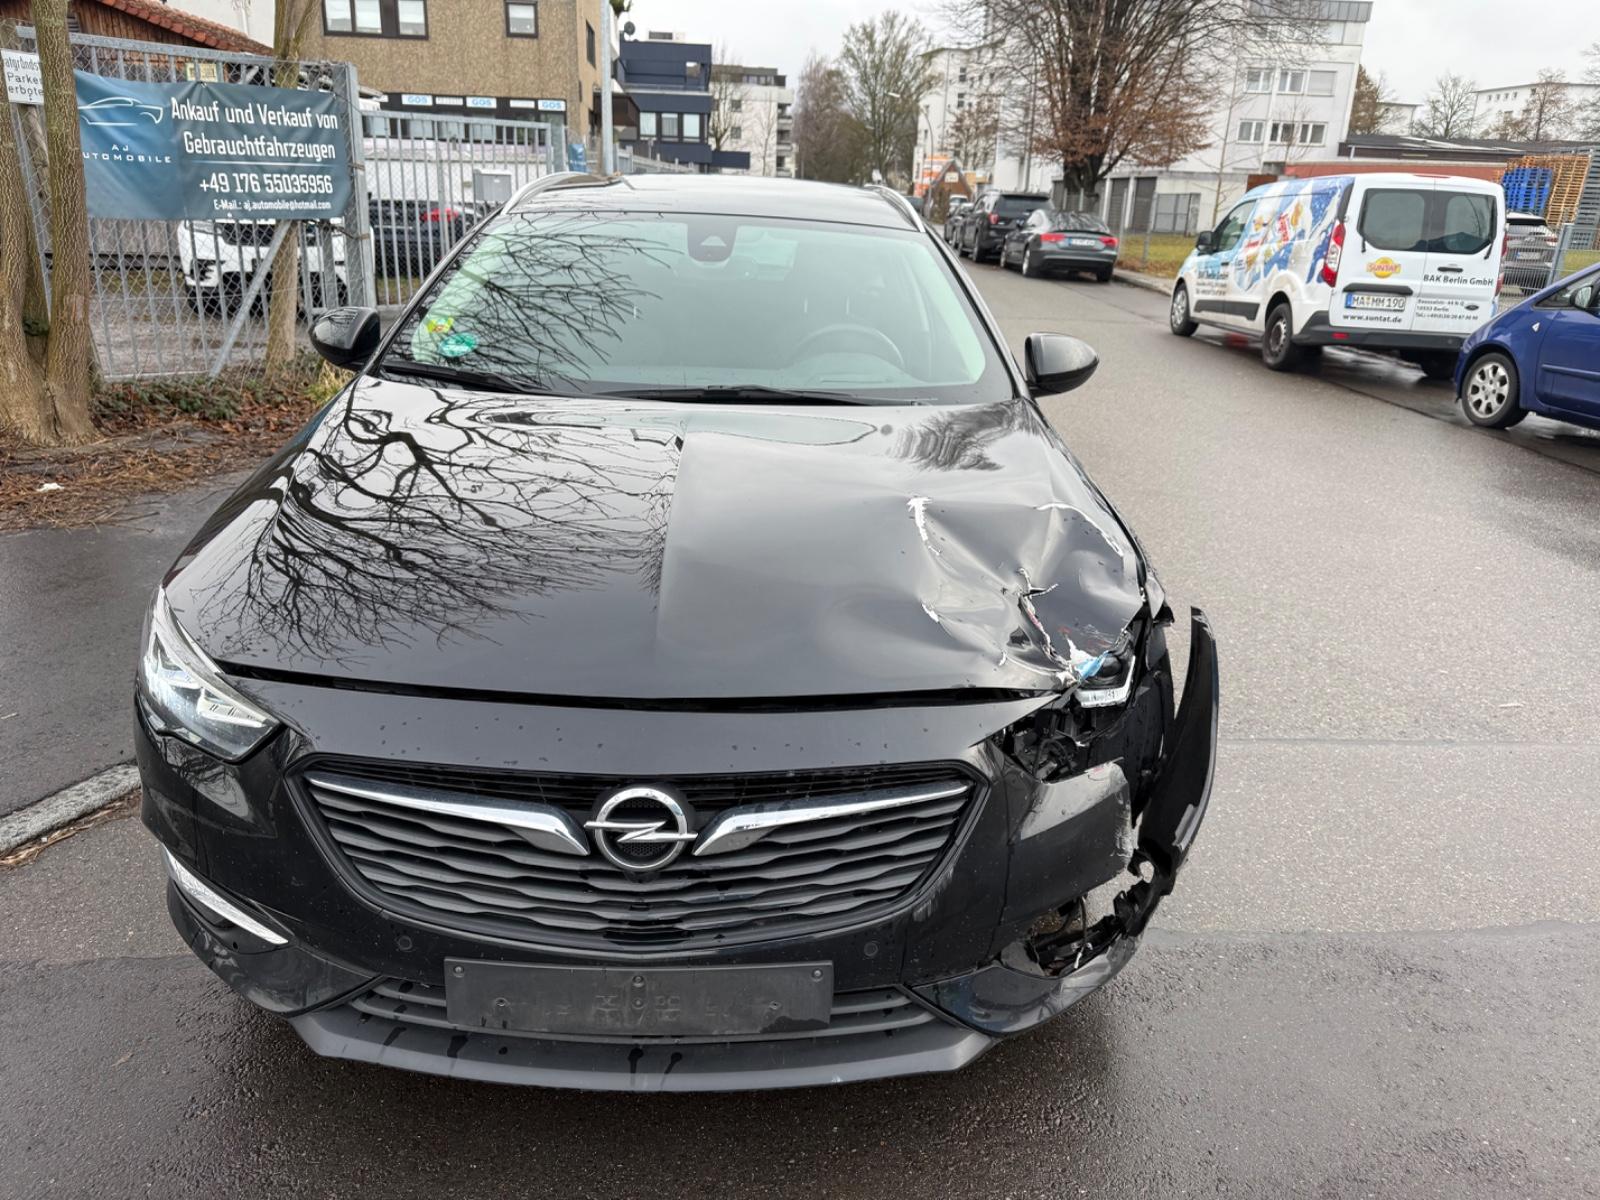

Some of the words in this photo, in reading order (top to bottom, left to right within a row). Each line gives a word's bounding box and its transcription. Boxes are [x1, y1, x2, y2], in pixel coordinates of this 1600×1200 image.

[7, 72, 43, 84] Parke
[8, 85, 44, 96] erbote
[407, 95, 428, 104] GOS
[471, 98, 492, 107] GOS
[542, 101, 562, 109] GOS
[171, 97, 219, 122] Ankauf
[225, 103, 254, 124] und
[257, 103, 313, 128] Verkauf
[315, 113, 339, 130] von
[183, 131, 336, 162] Gebrauchtfahrzeugen
[82, 152, 172, 163] UTOMOBILE
[200, 172, 230, 193] +49
[232, 173, 261, 193] 176
[263, 174, 333, 194] 55035956
[243, 200, 332, 212] aj.automobile@hotmail.com
[1367, 262, 1399, 273] SUNTAT
[1423, 274, 1442, 282] BAK
[1443, 275, 1468, 285] Berlin
[1469, 277, 1494, 286] GmbH
[1353, 296, 1365, 306] MA
[1386, 298, 1405, 309] 190
[1342, 314, 1403, 323] www.suntat.de
